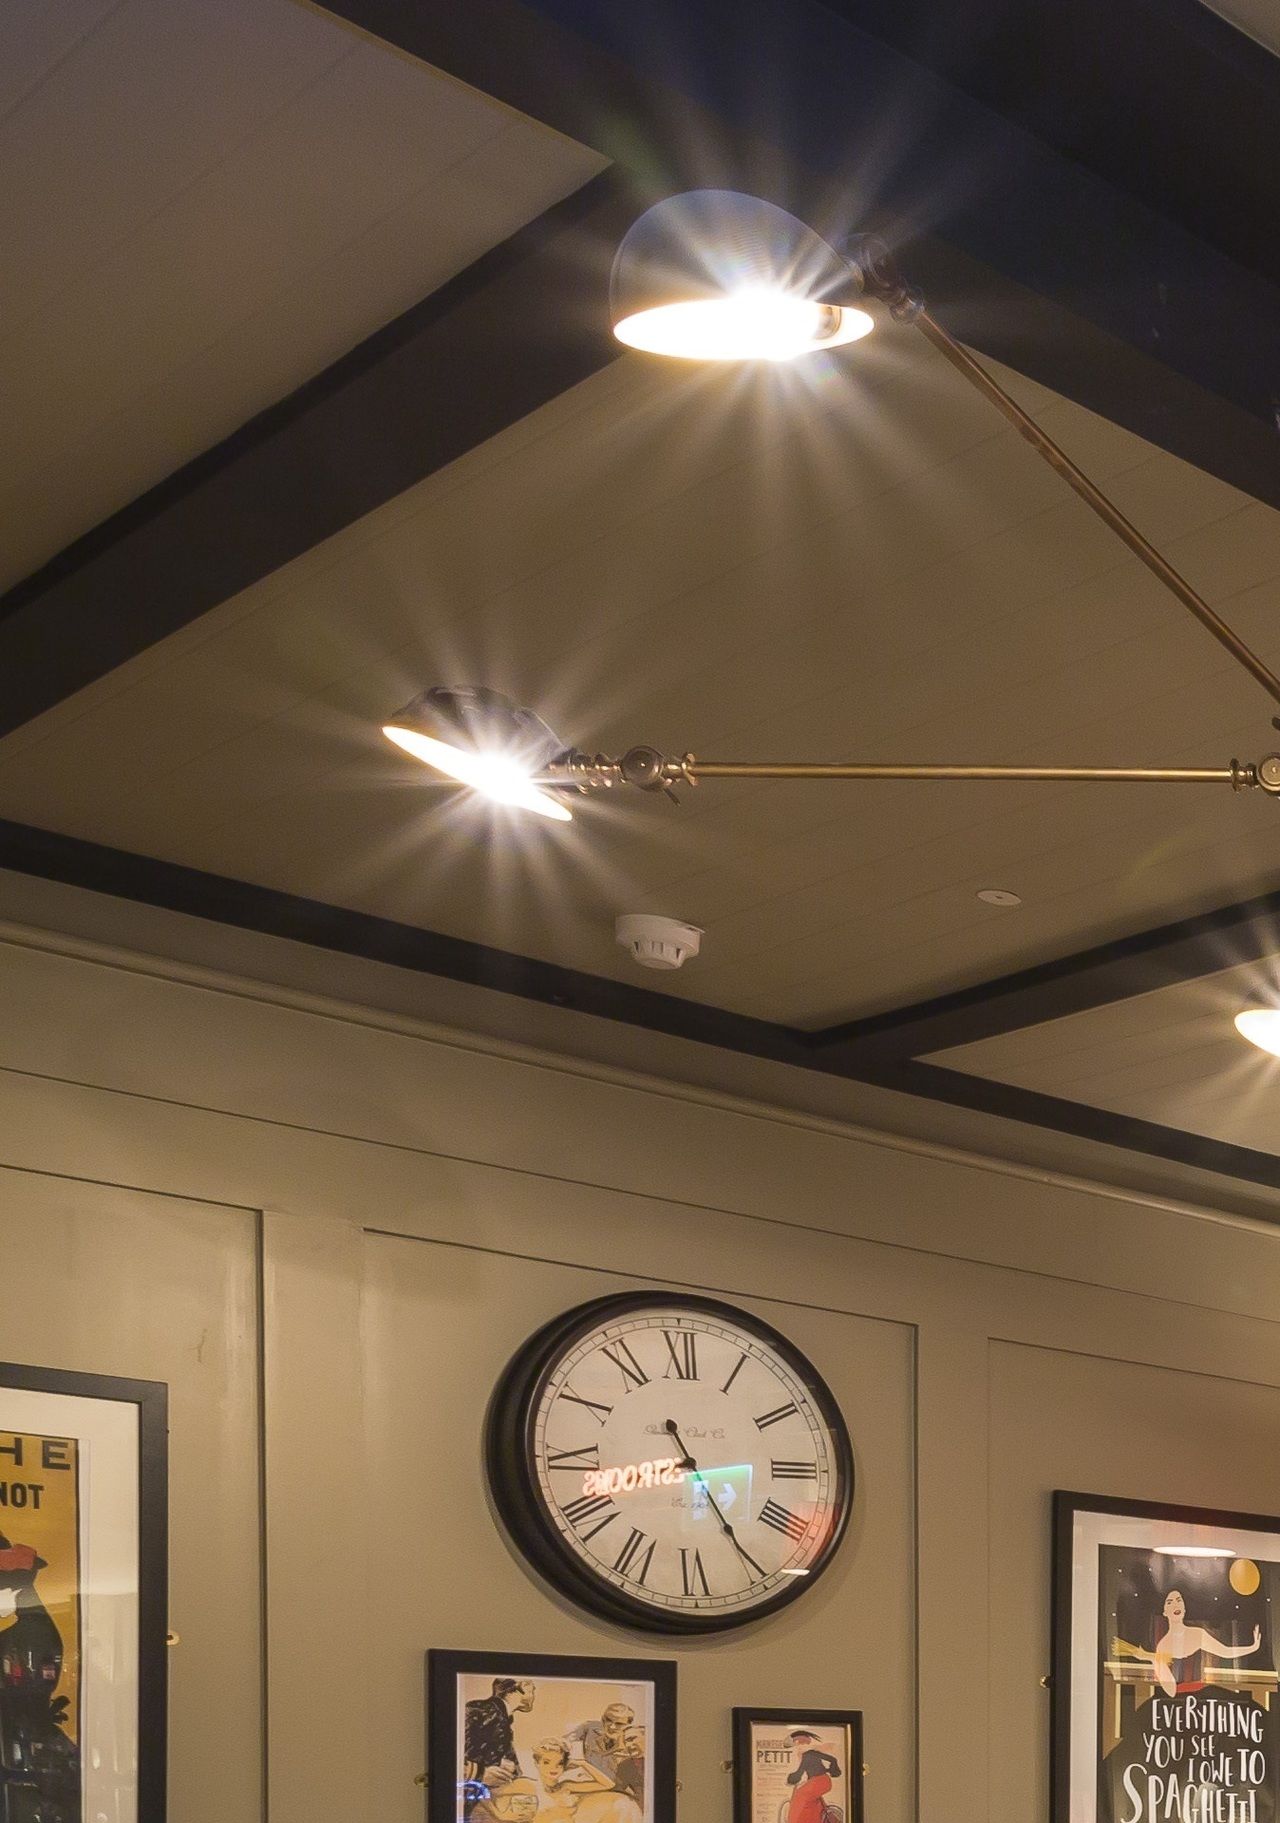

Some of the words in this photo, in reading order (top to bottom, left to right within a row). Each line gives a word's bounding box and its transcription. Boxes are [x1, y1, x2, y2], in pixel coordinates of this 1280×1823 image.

[660, 1329, 701, 1381] XII
[1152, 1695, 1264, 1743] EVERYTHING
[756, 1750, 794, 1763] PETIT
[1143, 1732, 1184, 1768] YOU
[1191, 1735, 1216, 1757] SEE
[1187, 1758, 1195, 1783] I
[1199, 1752, 1234, 1787] OWE
[1237, 1749, 1265, 1785] TO
